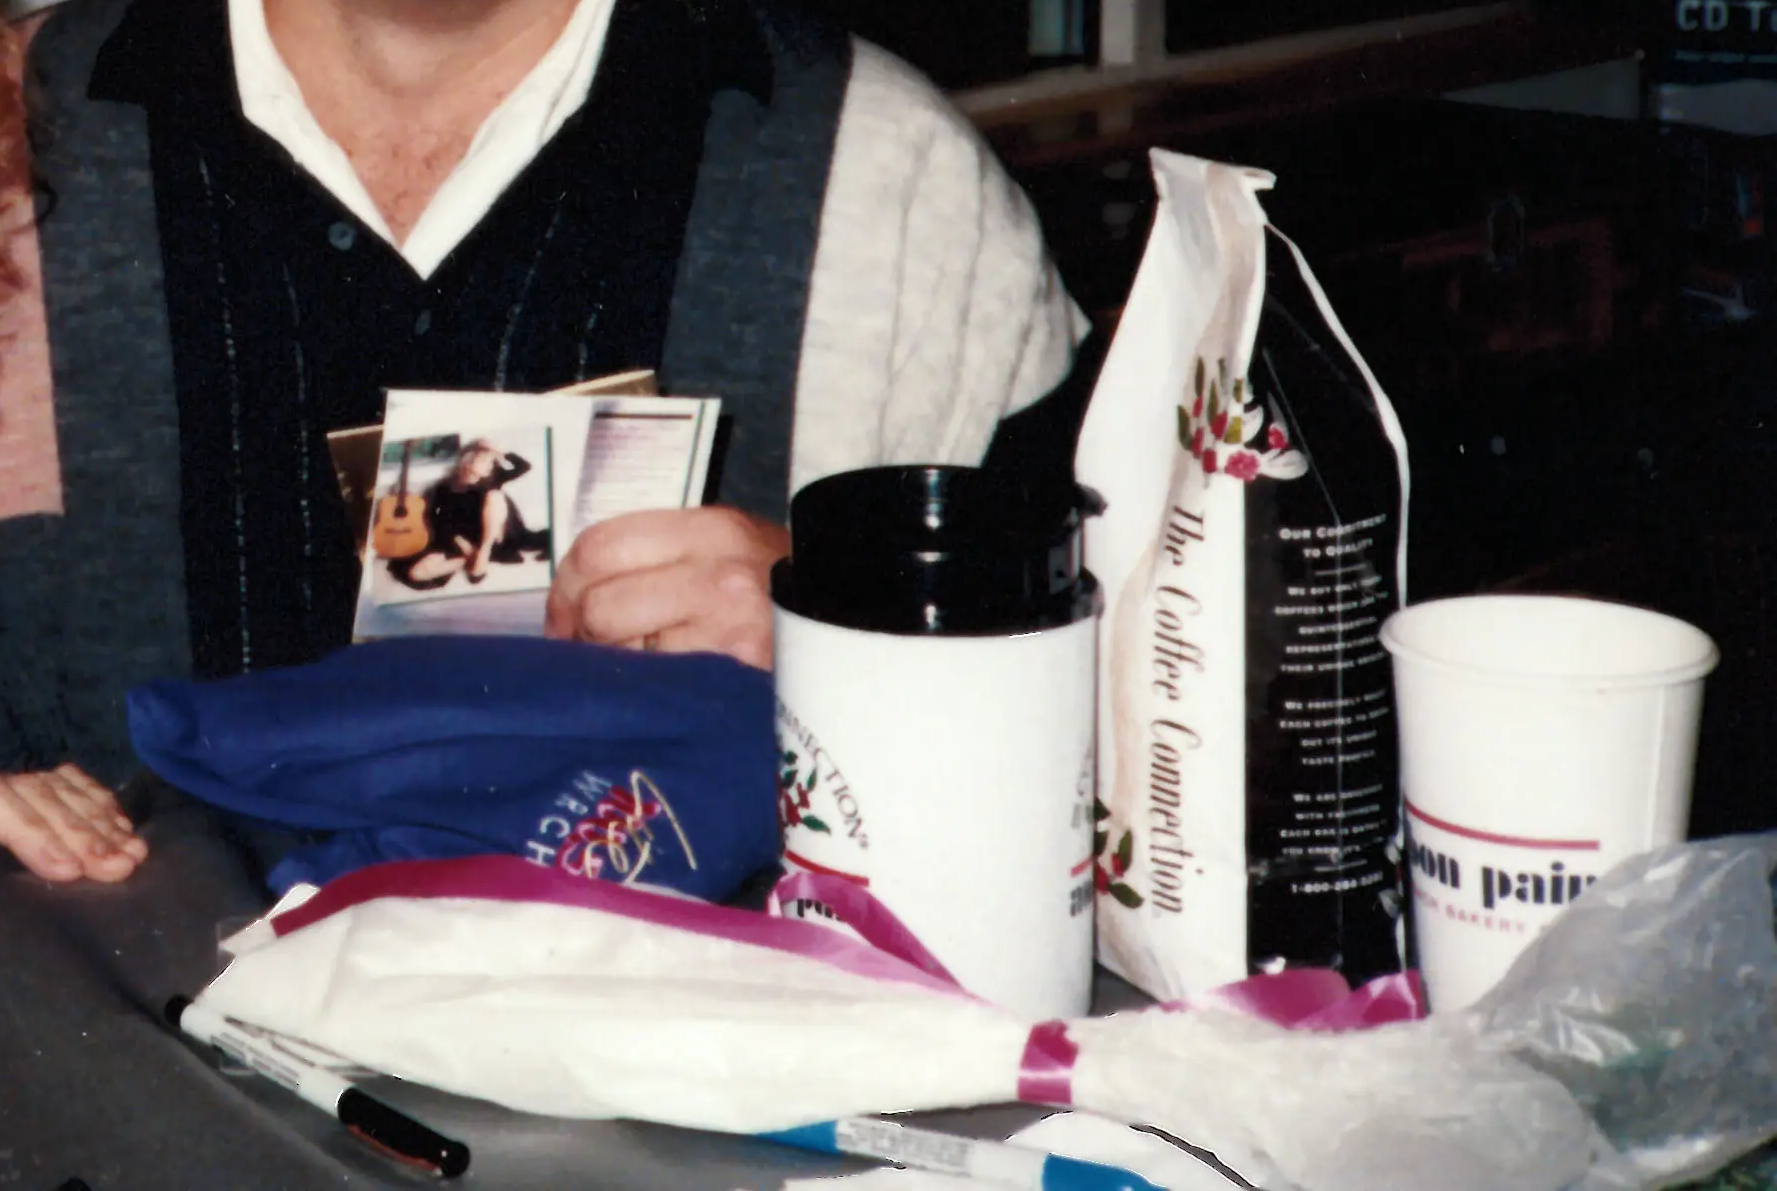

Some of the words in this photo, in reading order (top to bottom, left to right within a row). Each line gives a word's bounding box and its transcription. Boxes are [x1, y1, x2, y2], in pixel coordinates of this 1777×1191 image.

[1164, 502, 1205, 566] The
[1152, 585, 1205, 700] Coffee
[525, 770, 613, 868] WRCH
[1149, 719, 1203, 913] Connection
